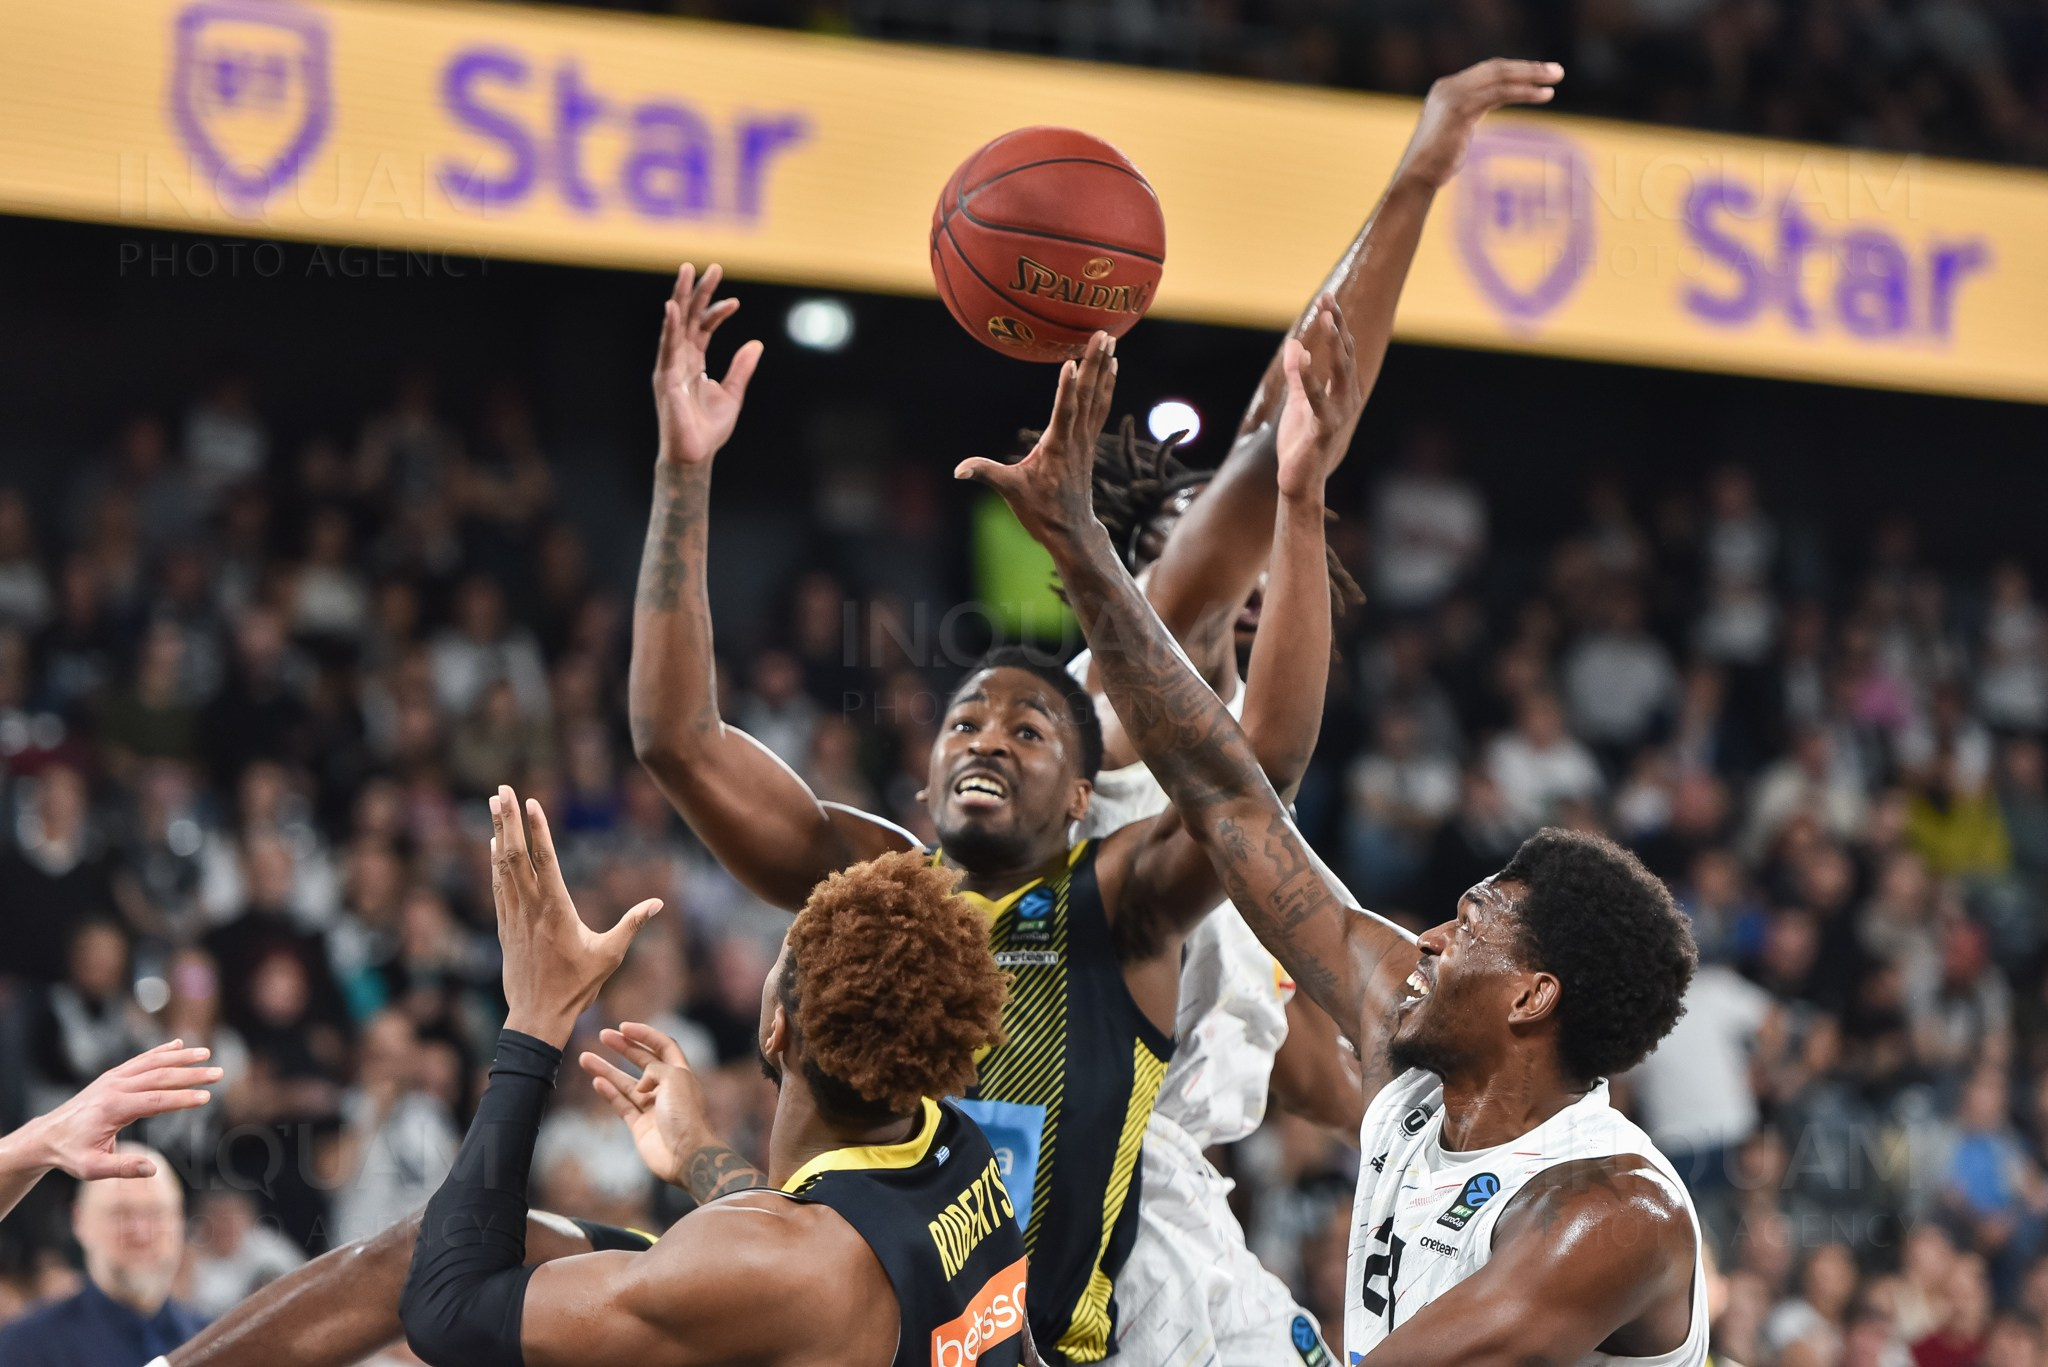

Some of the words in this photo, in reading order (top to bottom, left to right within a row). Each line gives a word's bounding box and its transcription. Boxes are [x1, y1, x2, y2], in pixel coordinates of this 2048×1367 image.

[438, 45, 810, 224] Star
[1009, 256, 1152, 314] SPALDING
[1680, 178, 1990, 345] Star
[995, 949, 1058, 965] oneteam
[928, 1157, 1014, 1282] ROBERTS
[1441, 1213, 1464, 1228] EuroCup
